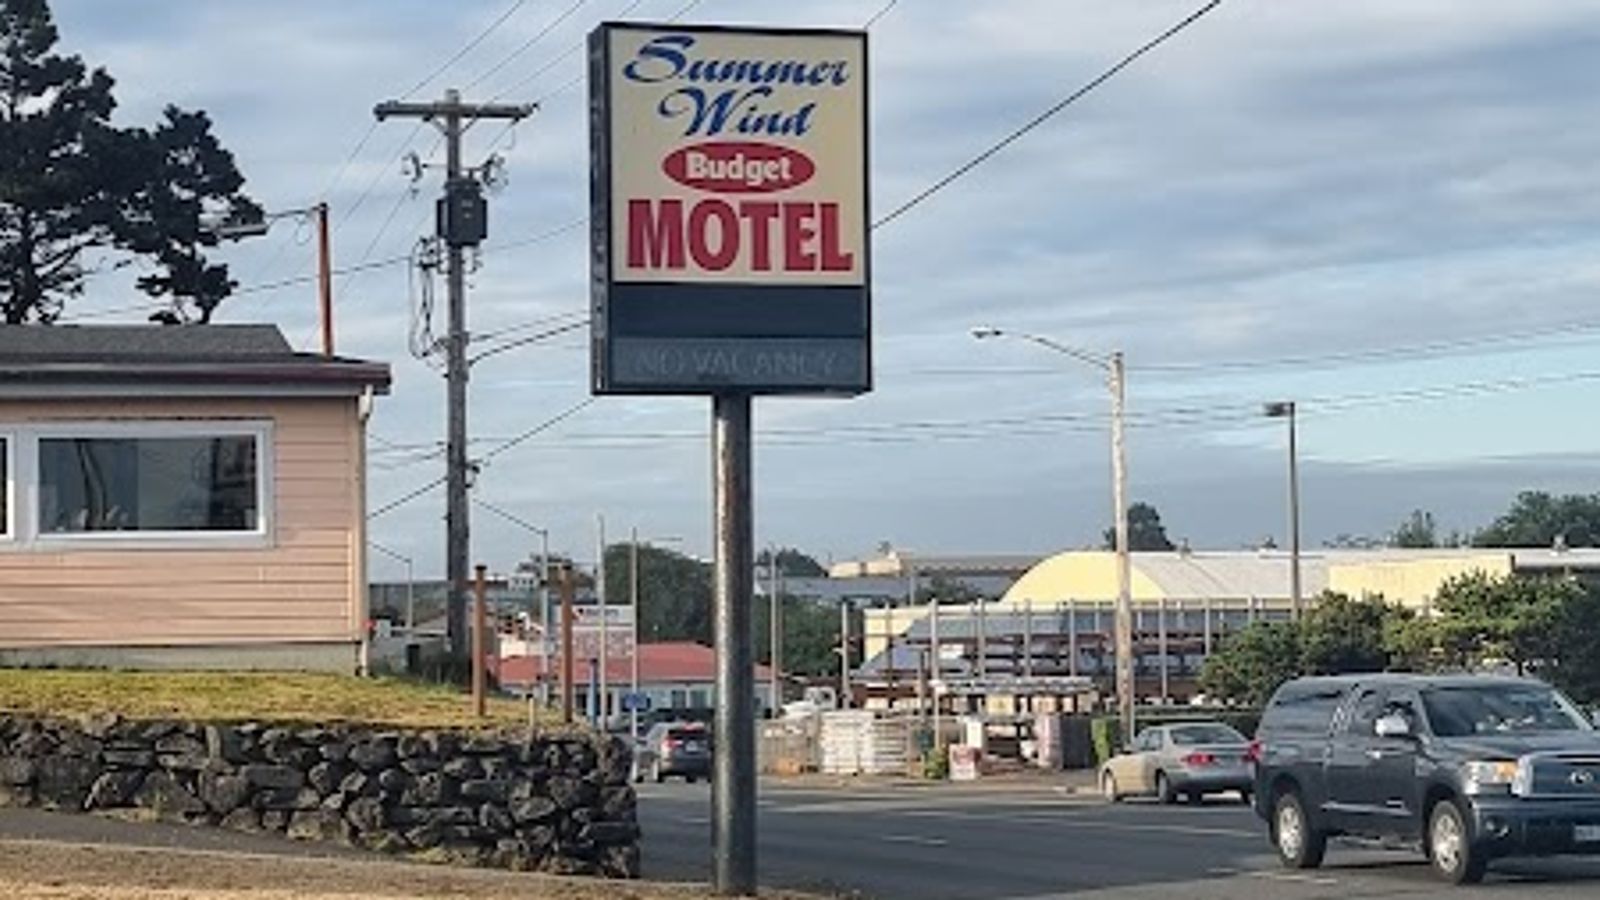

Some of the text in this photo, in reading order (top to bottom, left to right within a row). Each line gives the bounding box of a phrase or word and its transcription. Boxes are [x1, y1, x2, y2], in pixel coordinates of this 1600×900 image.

[623, 36, 849, 86] Summer
[658, 86, 816, 136] Wind
[686, 153, 791, 186] Budget
[627, 199, 853, 271] MOTEL
[635, 348, 839, 377] NO VACANCY
